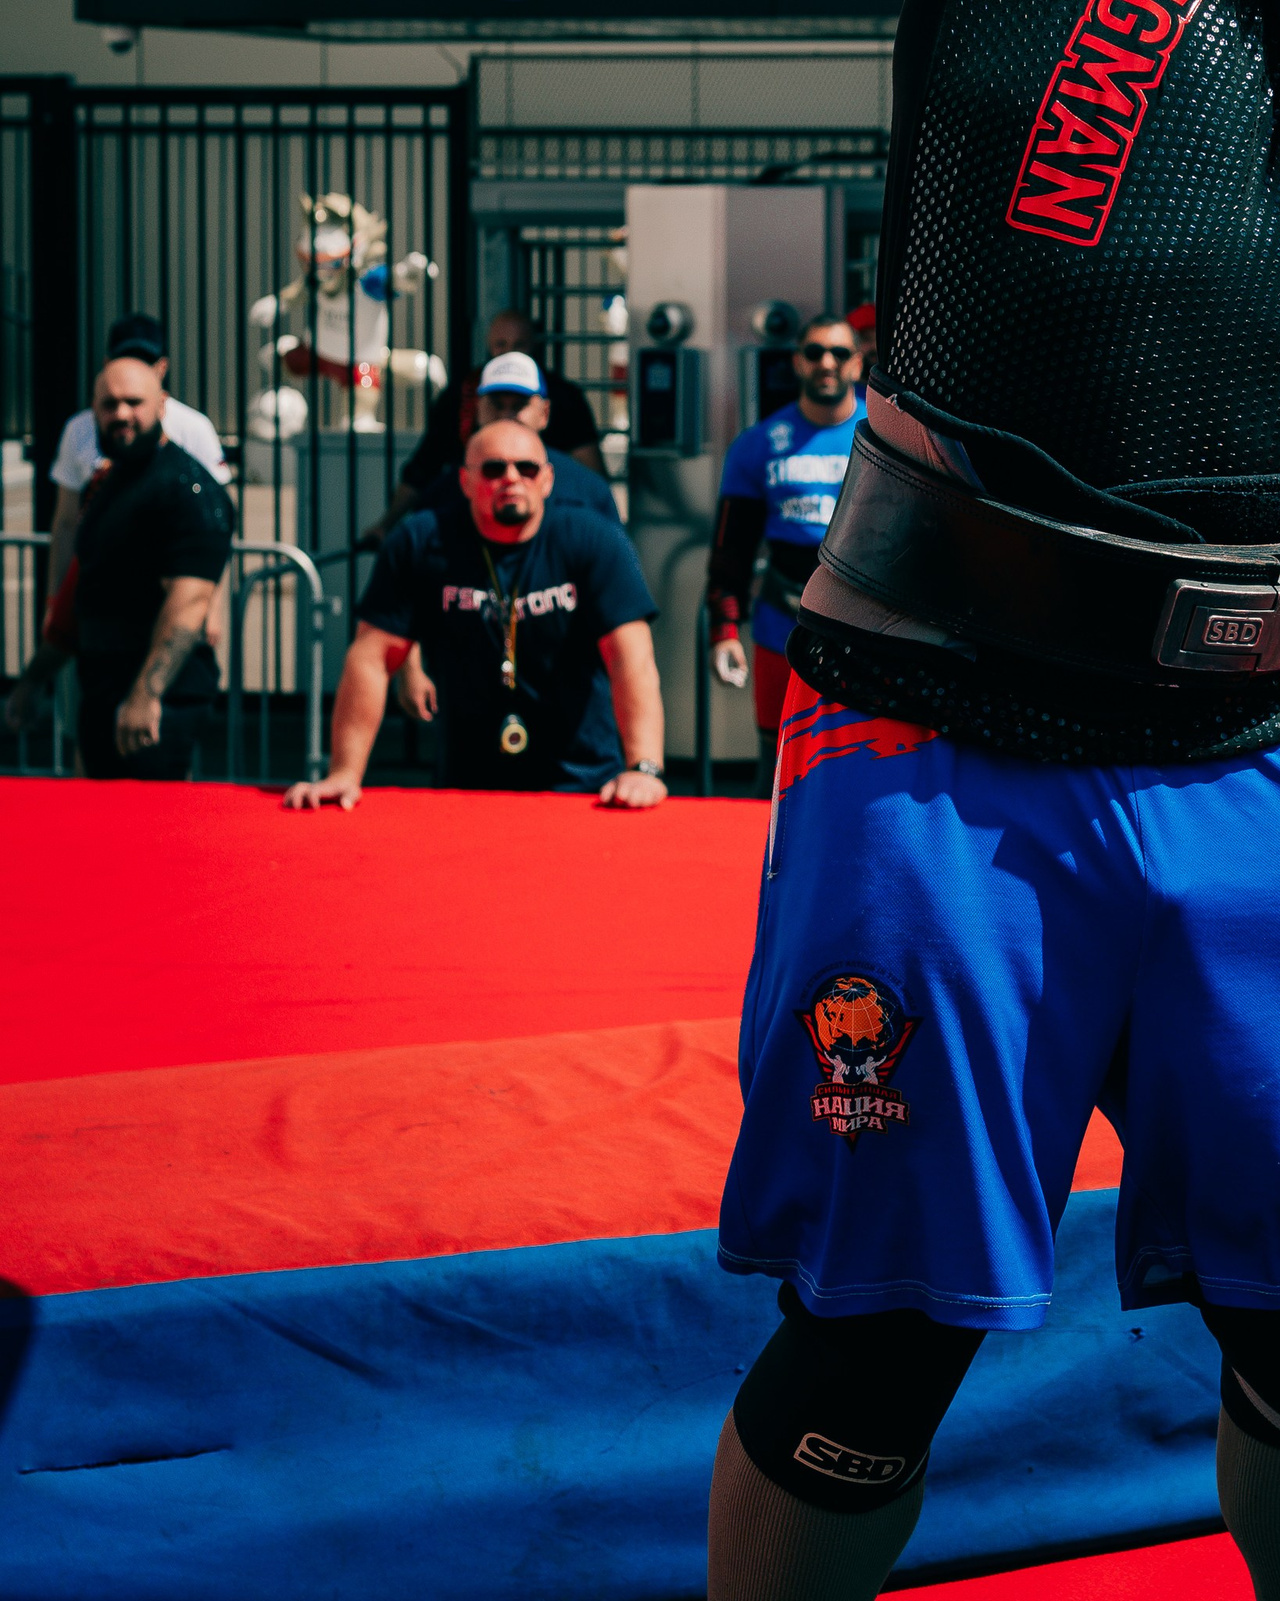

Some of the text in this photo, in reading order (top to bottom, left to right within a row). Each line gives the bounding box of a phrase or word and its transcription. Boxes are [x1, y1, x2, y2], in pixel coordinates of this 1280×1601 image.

[1208, 620, 1257, 643] SBD
[812, 1095, 906, 1121] НАЦИЯ
[831, 1115, 884, 1133] МИРА
[796, 1434, 904, 1482] SBD
